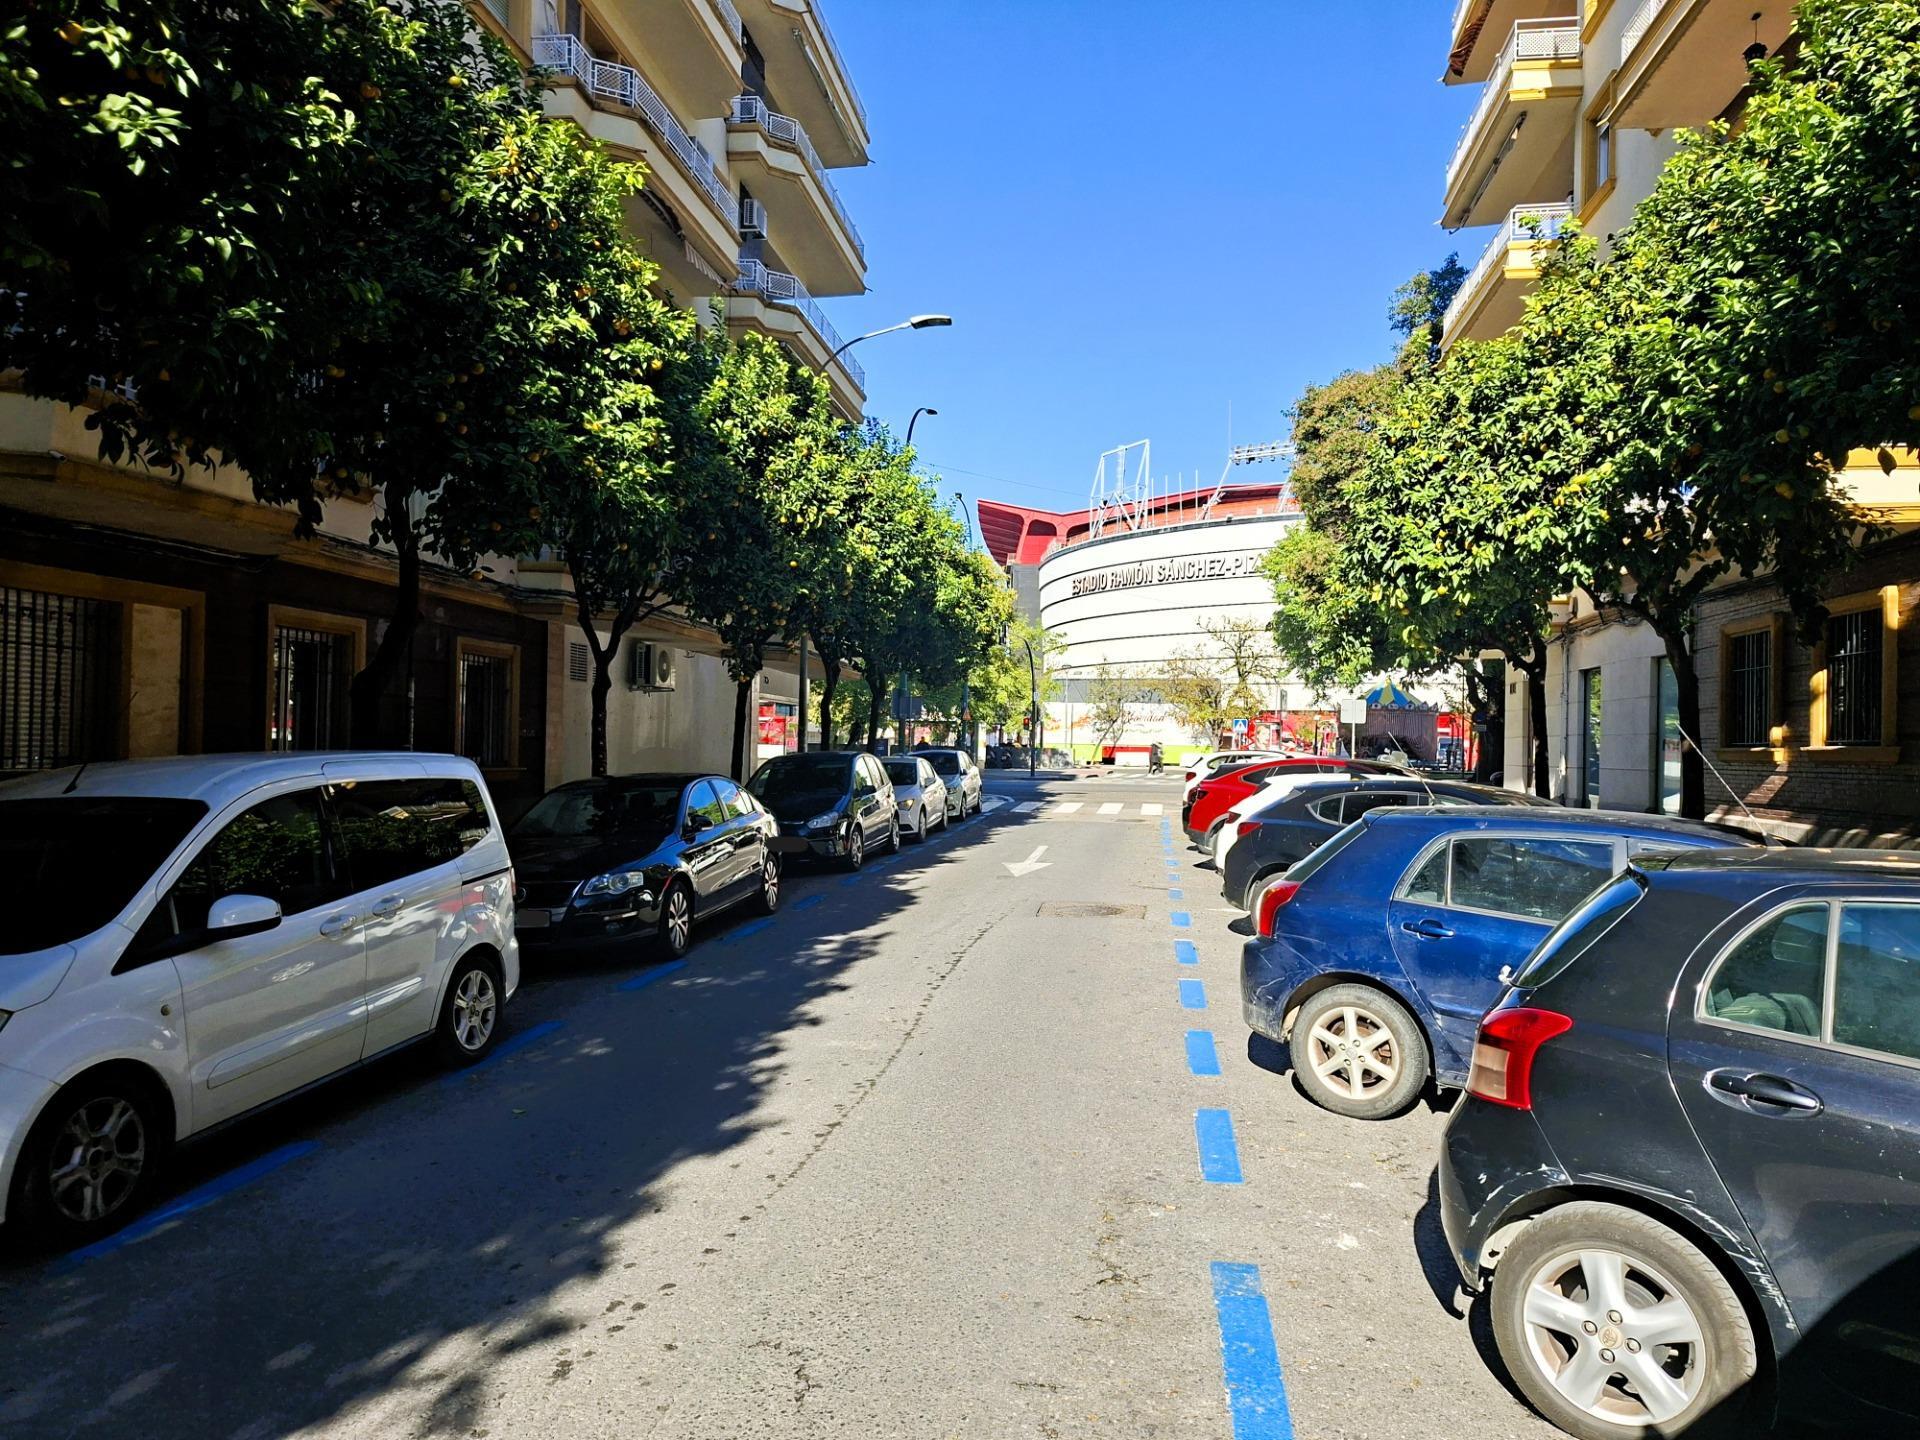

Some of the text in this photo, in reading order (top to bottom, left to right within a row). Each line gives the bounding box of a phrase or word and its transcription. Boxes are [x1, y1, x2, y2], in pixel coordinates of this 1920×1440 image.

[1072, 553, 1265, 596] ESTADIO RAMÓN SÁNCHEZ-PIZ
